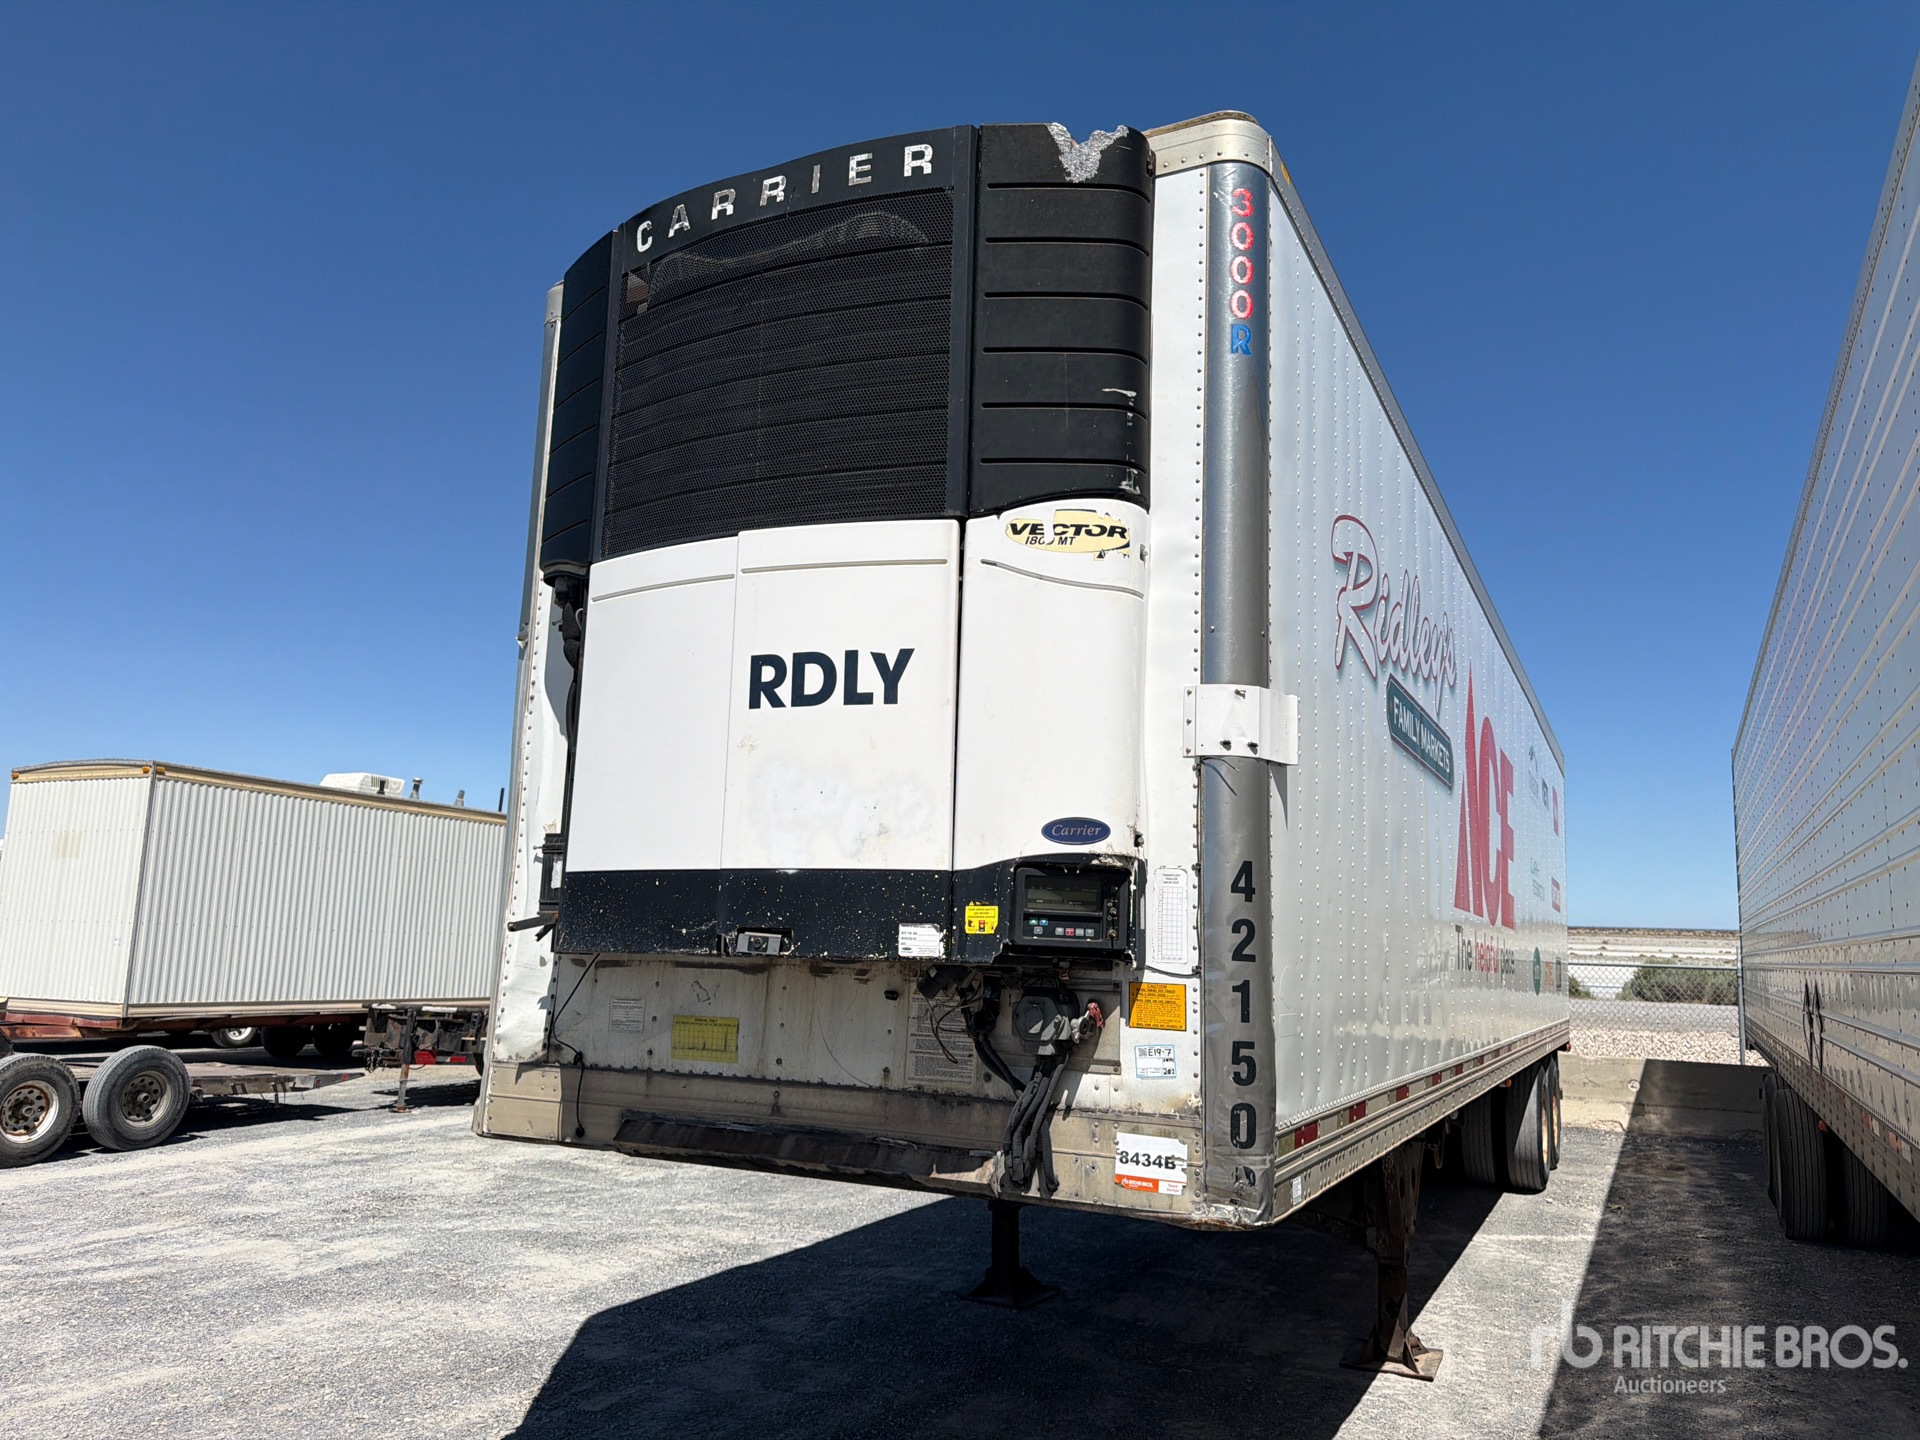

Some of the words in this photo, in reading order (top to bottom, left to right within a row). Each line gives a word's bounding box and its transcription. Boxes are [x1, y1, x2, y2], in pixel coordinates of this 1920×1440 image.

[636, 143, 933, 253] CARRIER
[1230, 188, 1254, 356] 3000R
[1010, 523, 1128, 539] VECTOR
[1057, 536, 1076, 545] MT
[1331, 514, 1457, 716] Ridley's
[748, 648, 916, 710] RDLY
[1393, 695, 1421, 746] FAMILY
[1420, 723, 1450, 773] MARKETS
[1051, 824, 1102, 836] Carrier
[1453, 659, 1515, 931] ACE
[1454, 924, 1473, 972] The
[1474, 929, 1499, 982] helpful
